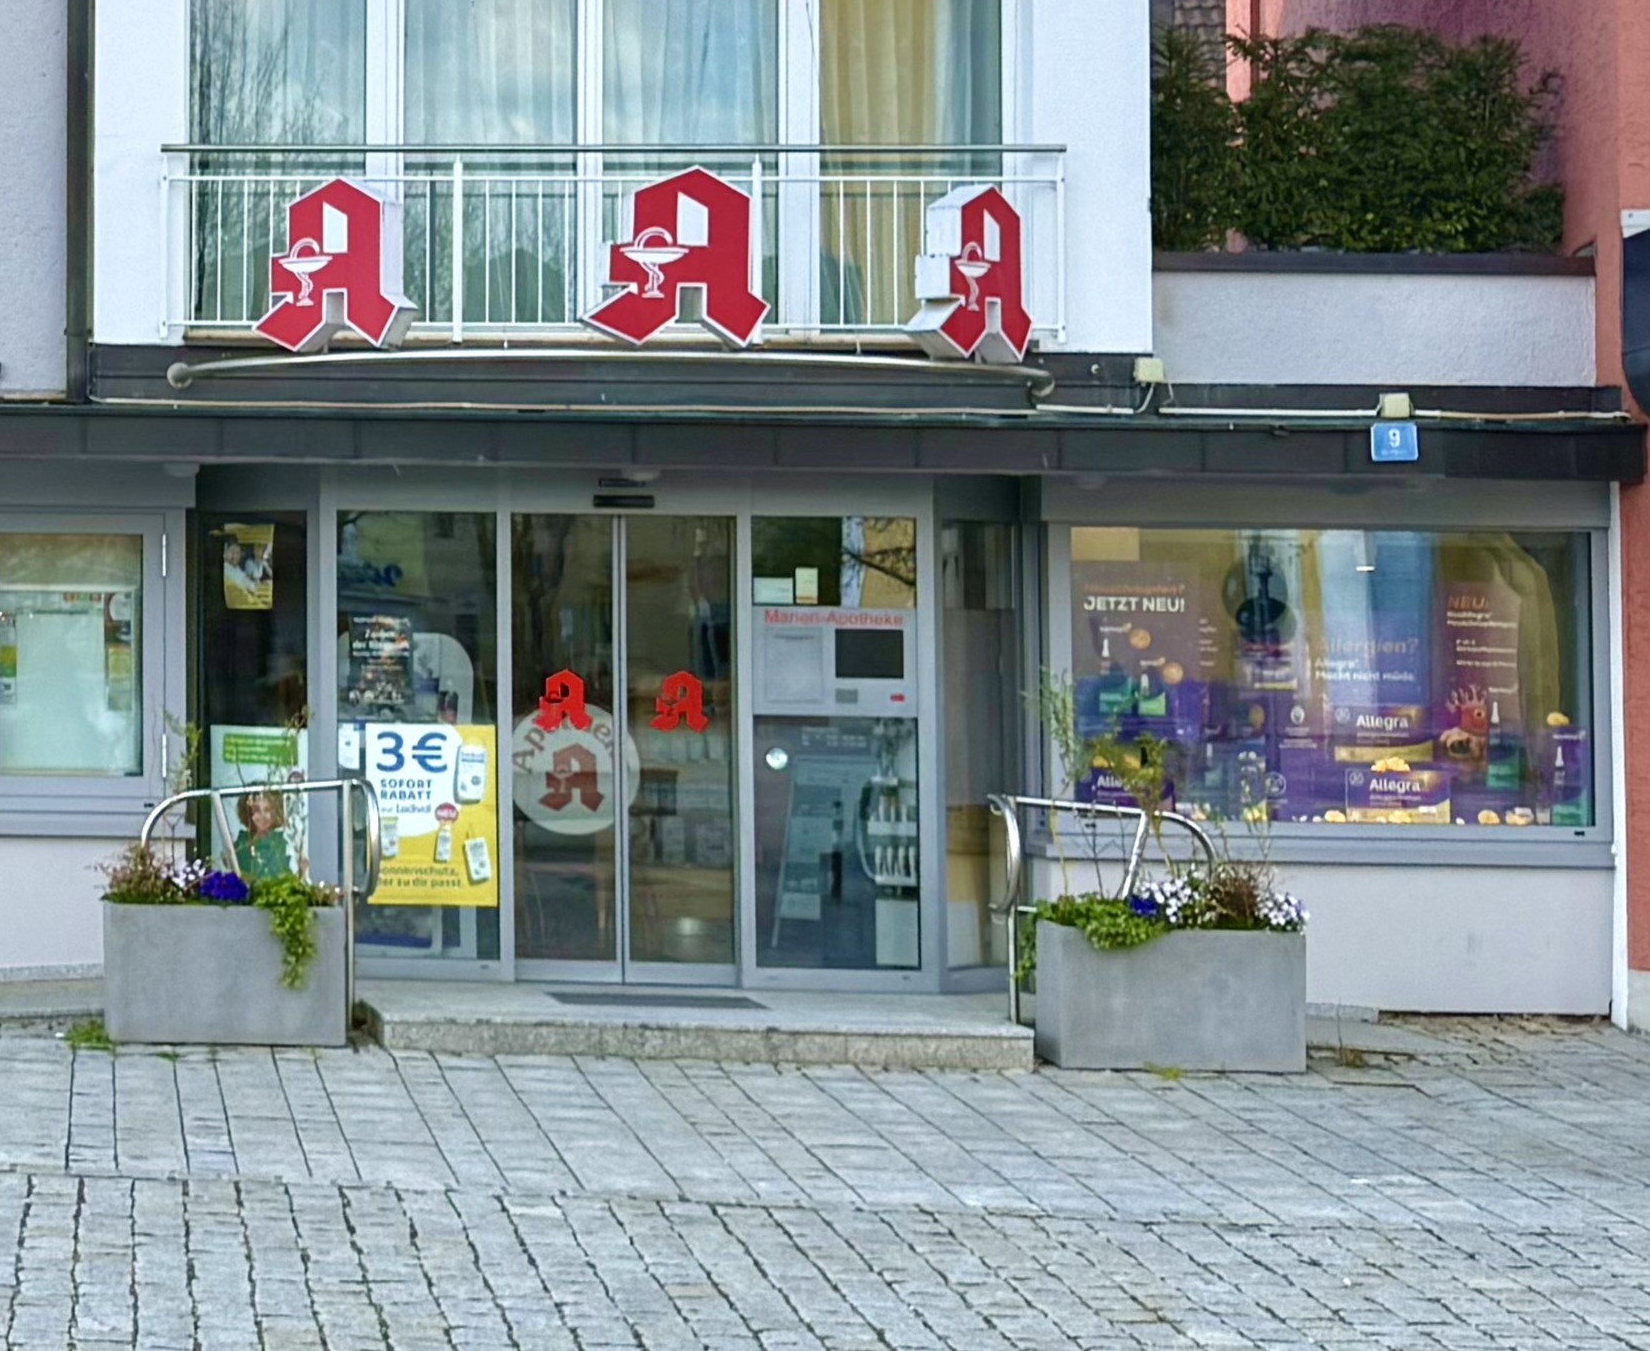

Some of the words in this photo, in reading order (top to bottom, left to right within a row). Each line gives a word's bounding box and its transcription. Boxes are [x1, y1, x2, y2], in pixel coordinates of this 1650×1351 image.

[1388, 428, 1401, 448] 9
[1083, 596, 1139, 612] JETZT
[1142, 597, 1186, 613] NEU!
[764, 609, 904, 627] Marien-Apotheke
[1356, 714, 1410, 731] Allegra
[380, 778, 432, 789] SOFORT
[1369, 778, 1422, 794] Allegra
[380, 790, 432, 801] RABATT
[380, 865, 459, 877] onnenschutz,
